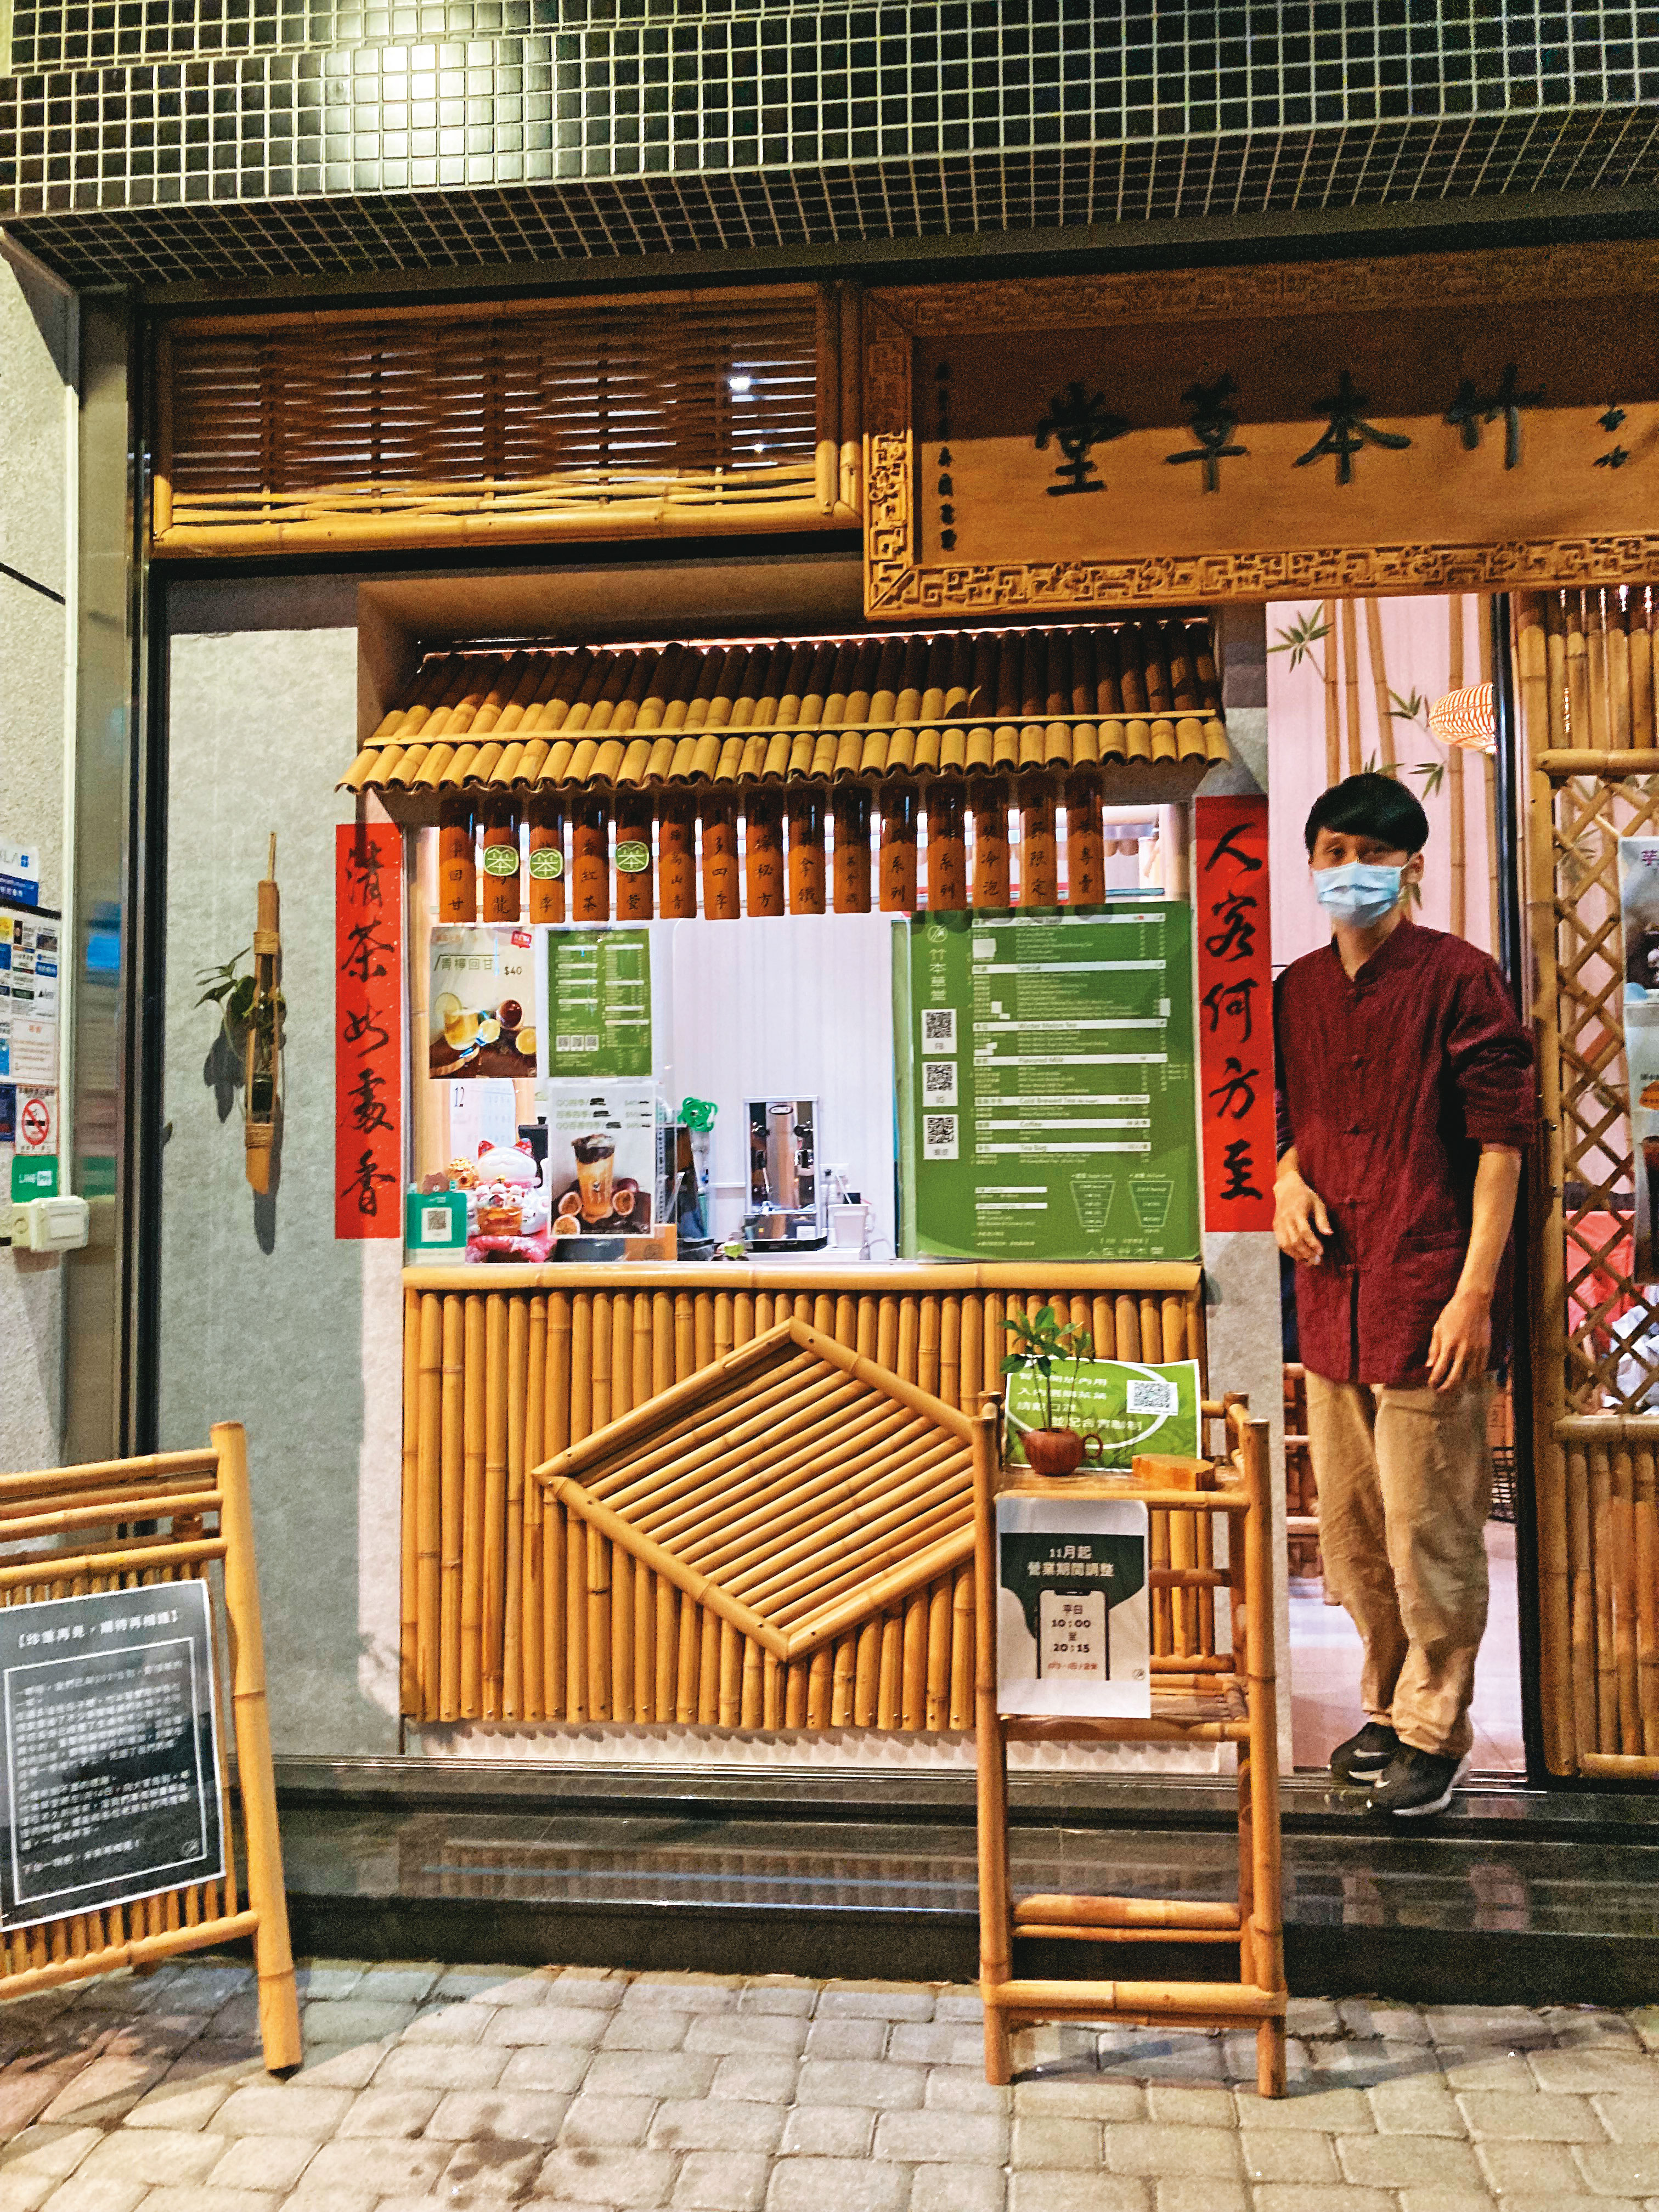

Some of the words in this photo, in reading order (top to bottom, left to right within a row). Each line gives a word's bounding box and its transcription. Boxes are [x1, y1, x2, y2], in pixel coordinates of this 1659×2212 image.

[504, 966, 522, 975] $40
[1048, 1545, 1092, 1559] 11月起
[1063, 1604, 1084, 1615] 平日
[1068, 1632, 1077, 1641] 至
